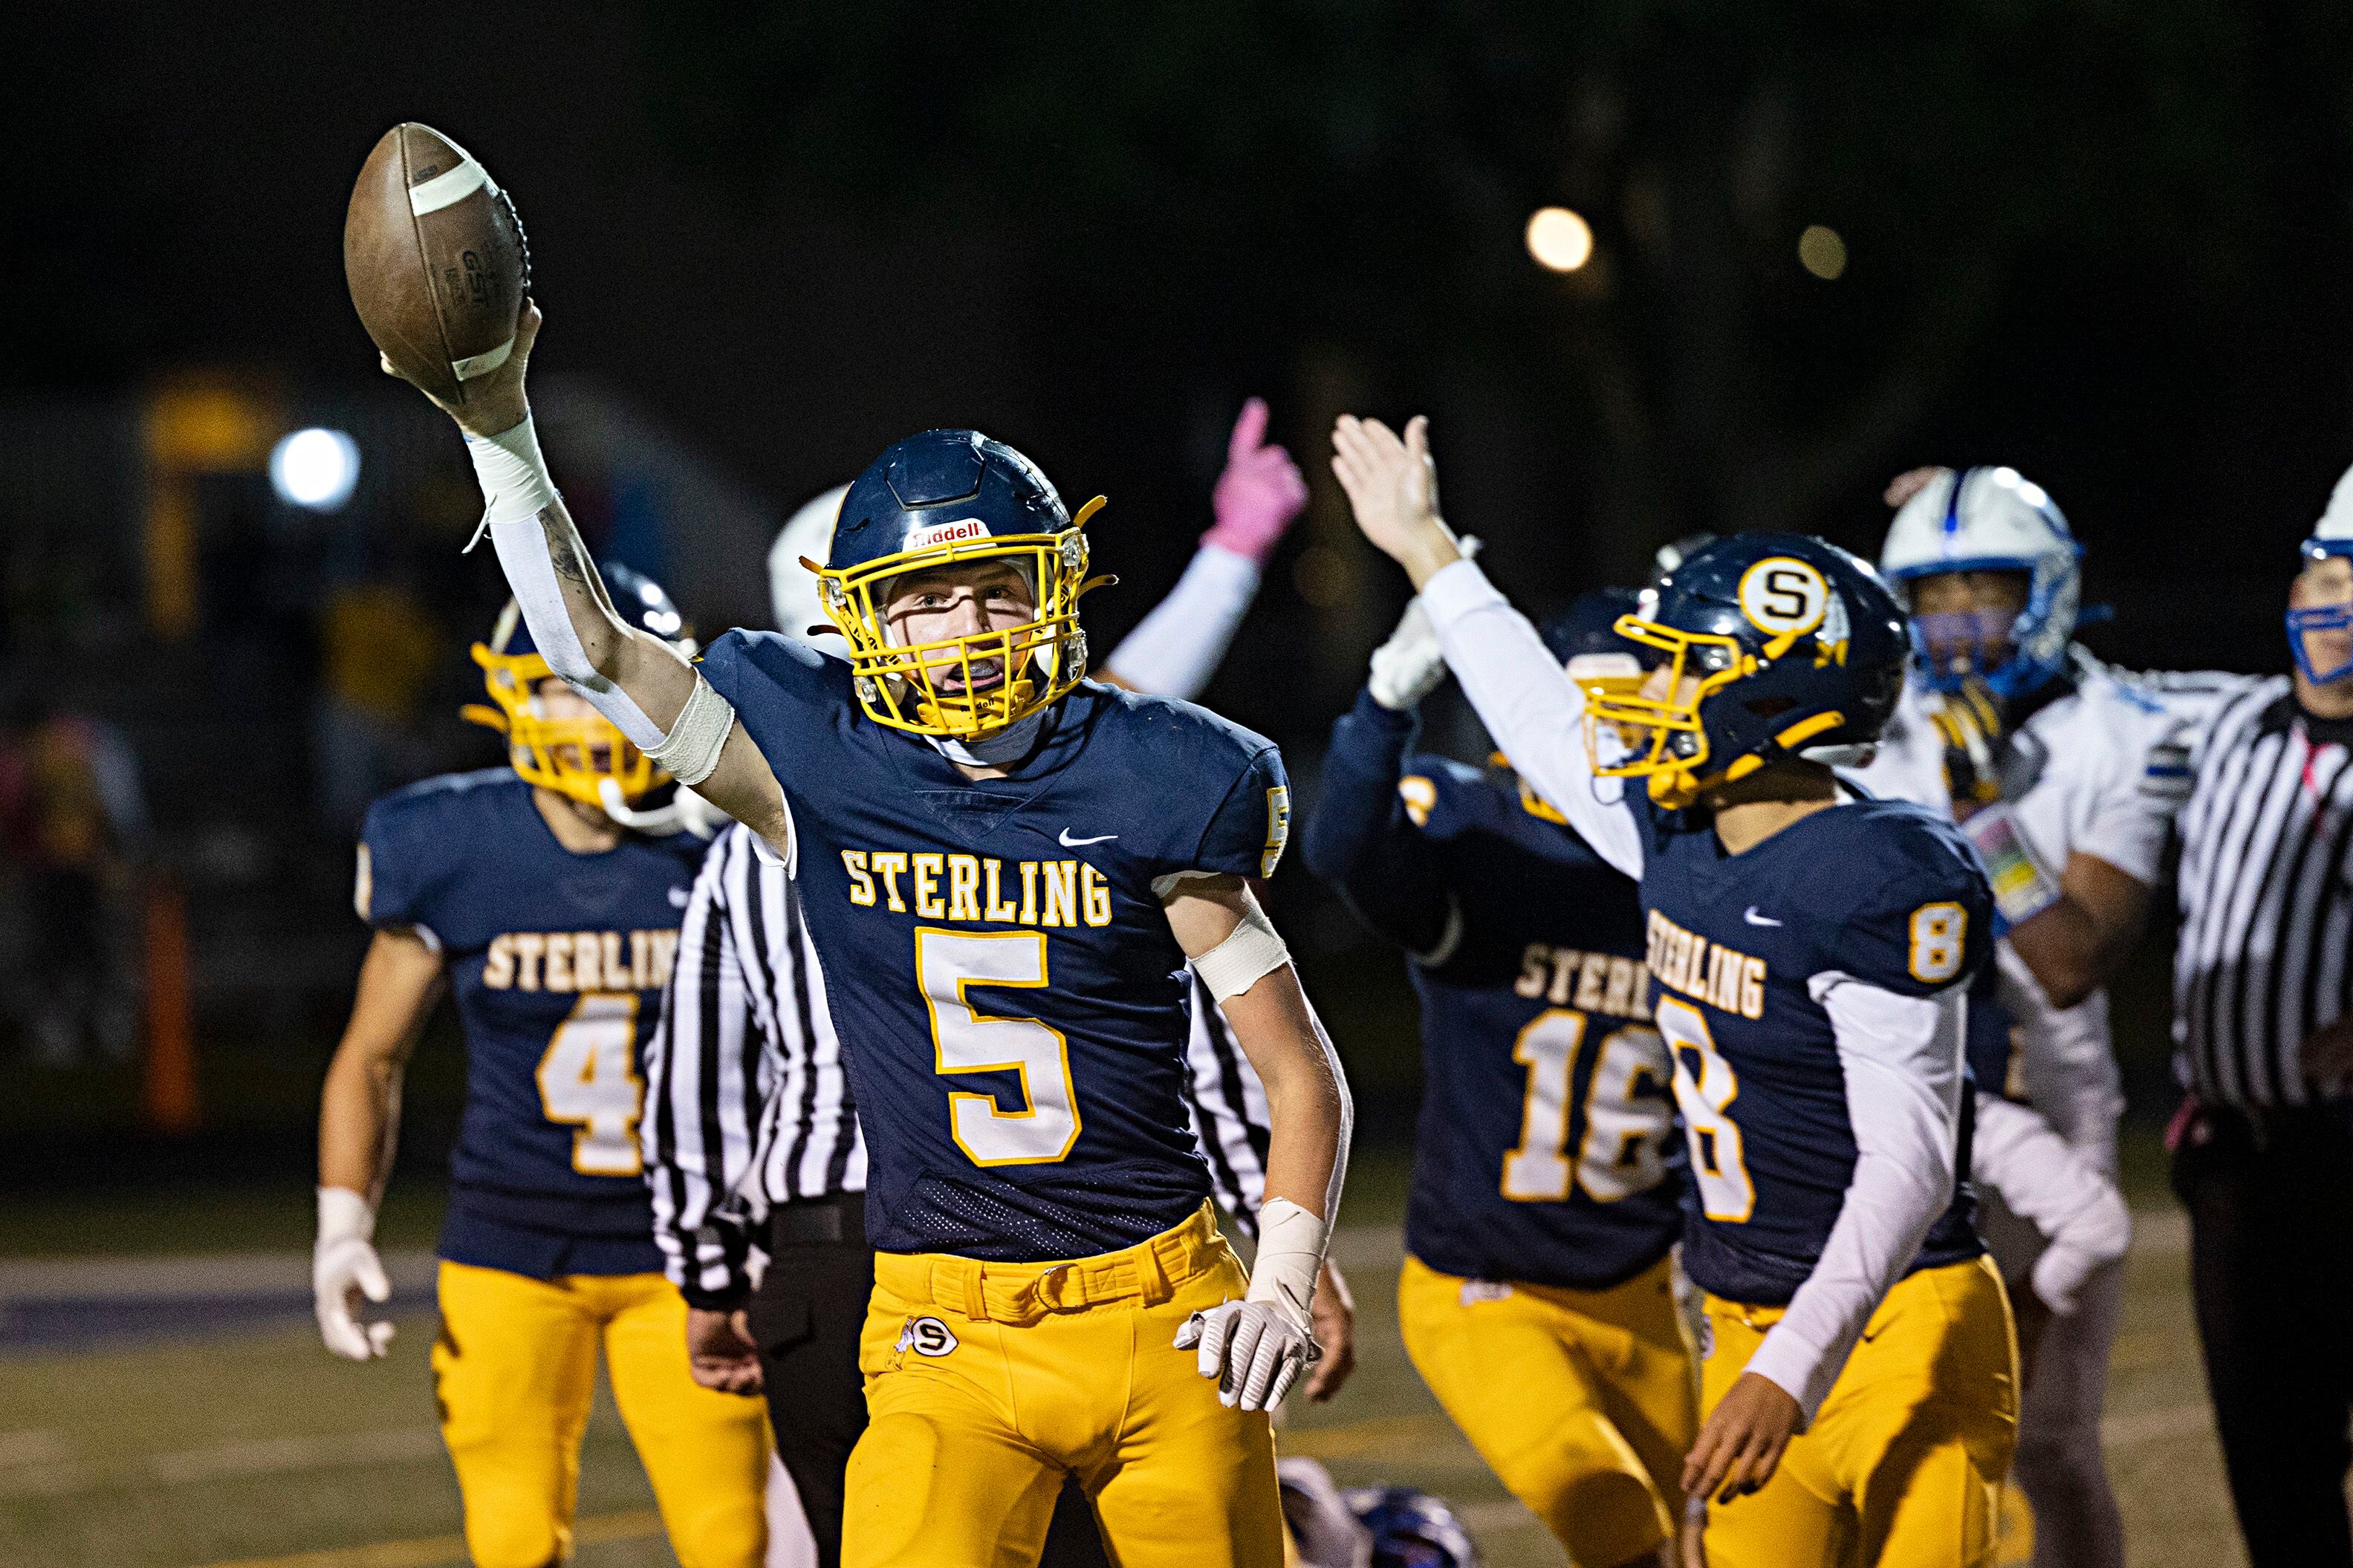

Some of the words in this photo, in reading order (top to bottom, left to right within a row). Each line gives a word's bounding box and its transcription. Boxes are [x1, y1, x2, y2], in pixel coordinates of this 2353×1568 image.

[912, 522, 979, 547] Riddell
[1764, 570, 1808, 619] S
[841, 850, 1112, 927] STERLING
[483, 929, 681, 993] STERLIN
[1646, 908, 1767, 1020] STERLING
[1907, 901, 1968, 983] 8
[535, 989, 646, 1177] 4
[915, 926, 1083, 1167] 5
[1499, 1007, 1675, 1203] 16
[1654, 994, 1756, 1223] 8
[919, 1324, 947, 1350] S
